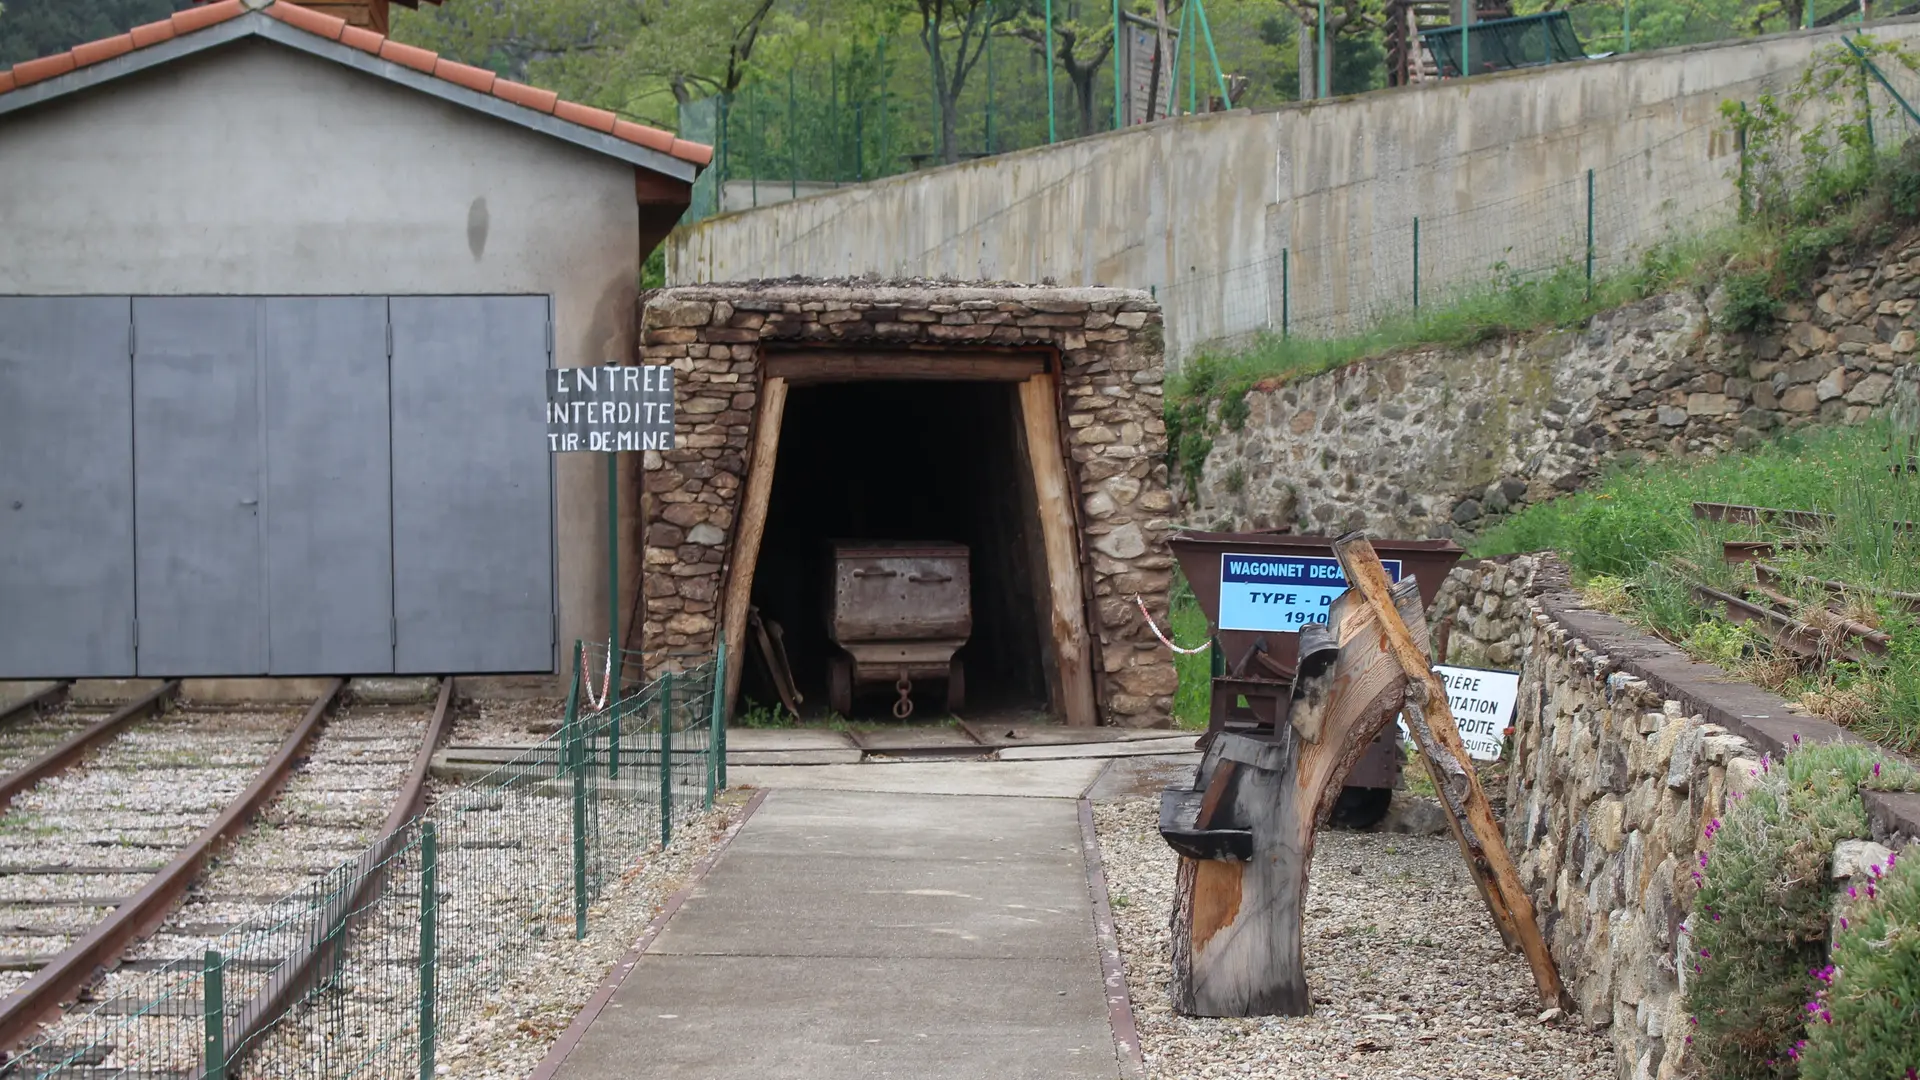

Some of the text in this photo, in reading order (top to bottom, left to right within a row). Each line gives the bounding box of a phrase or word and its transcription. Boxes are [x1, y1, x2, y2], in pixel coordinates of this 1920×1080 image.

[557, 366, 672, 393] ENTREE
[546, 401, 672, 424] INTERDITE
[1229, 561, 1345, 579] WAGONNET DECA
[1249, 592, 1297, 605] TYPE
[1284, 611, 1328, 624] 1910
[1447, 695, 1499, 715] ITATION
[1453, 717, 1496, 736] RDITE
[1461, 738, 1499, 754] SUITES
